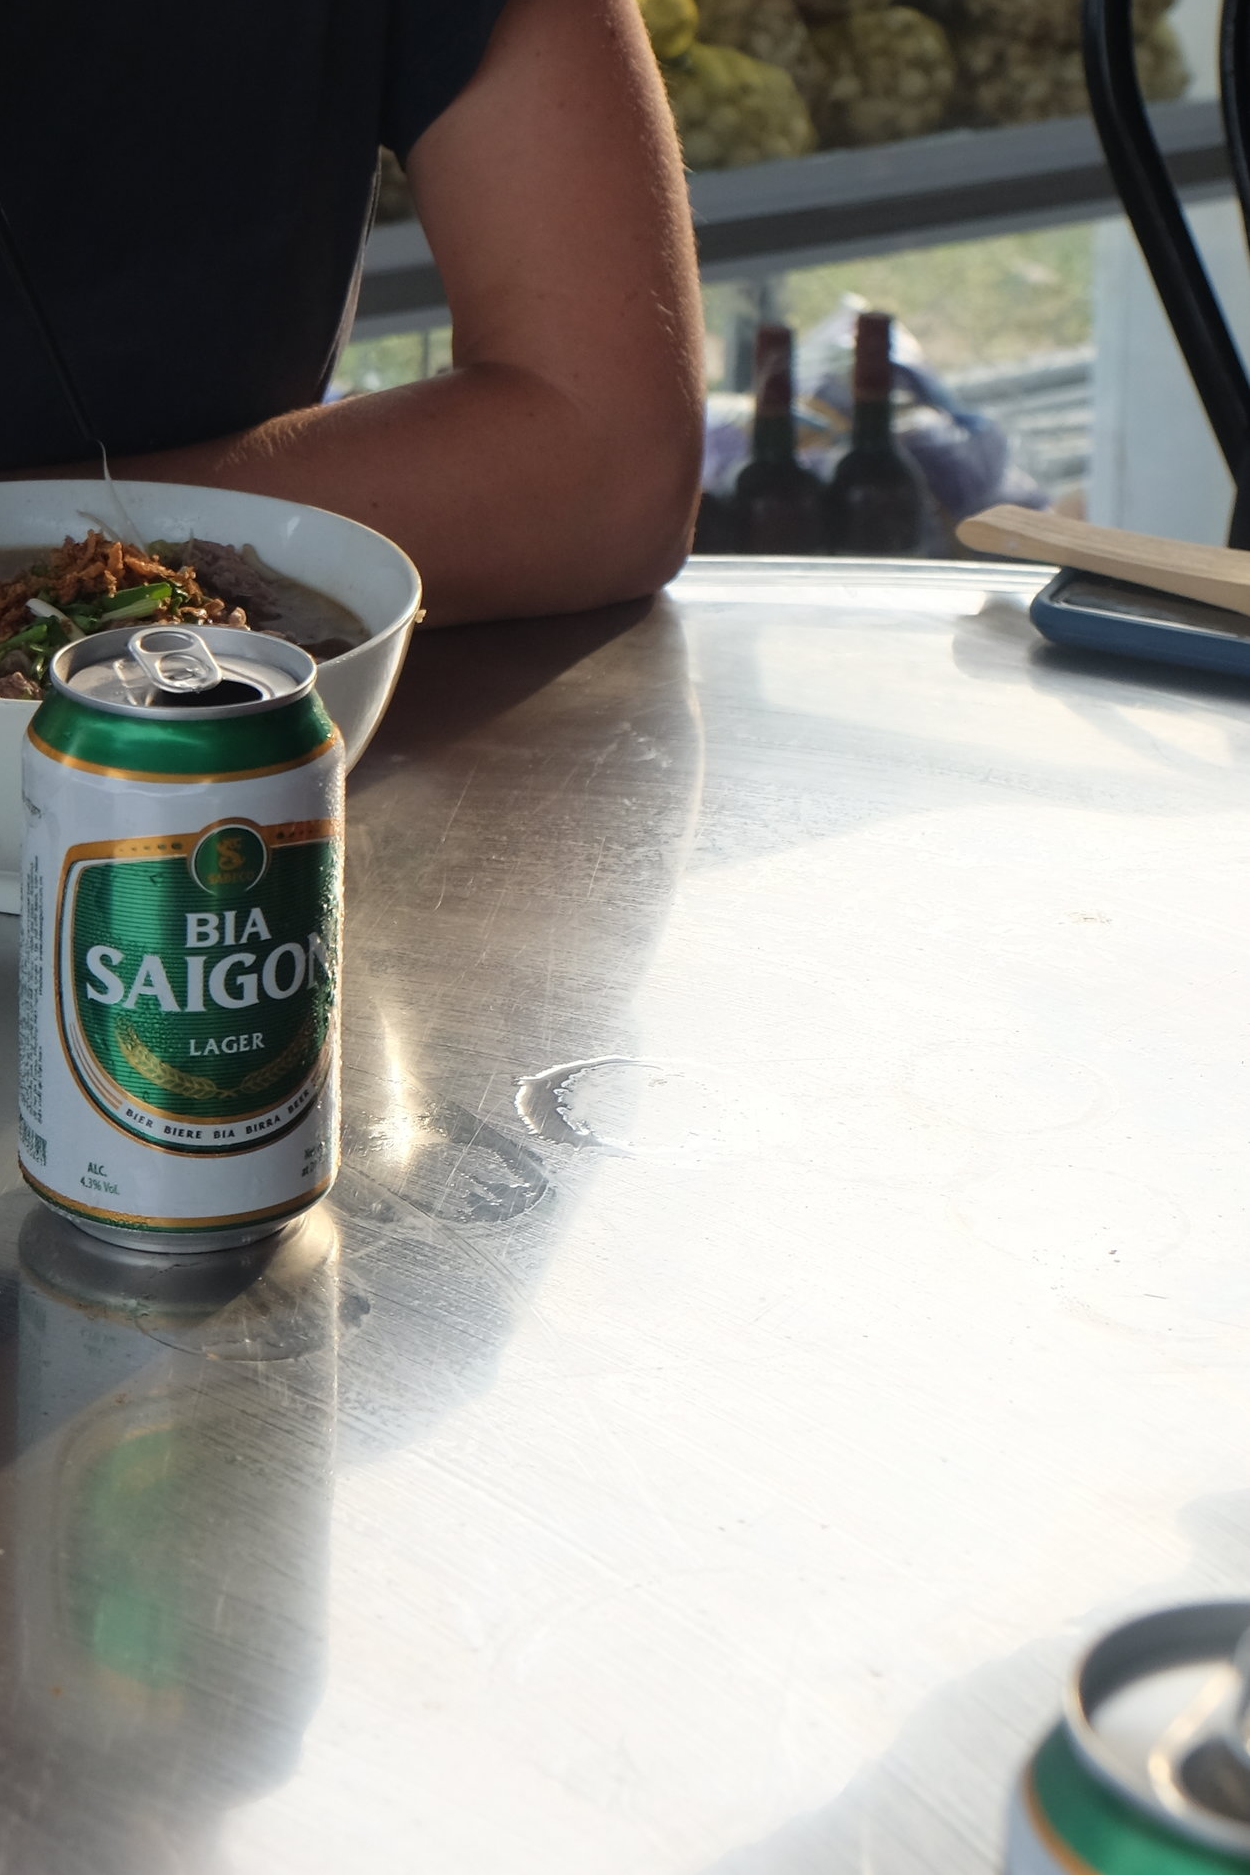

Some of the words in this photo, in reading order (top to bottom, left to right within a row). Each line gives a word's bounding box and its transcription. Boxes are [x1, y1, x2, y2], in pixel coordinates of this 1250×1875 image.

[185, 907, 272, 948] BIA
[189, 1032, 265, 1056] LAGER
[125, 1108, 154, 1129] BIER
[163, 1125, 202, 1139] BIERE
[213, 1129, 235, 1139] BIA
[245, 1115, 281, 1135] BIRRA
[287, 1090, 310, 1114] BEER
